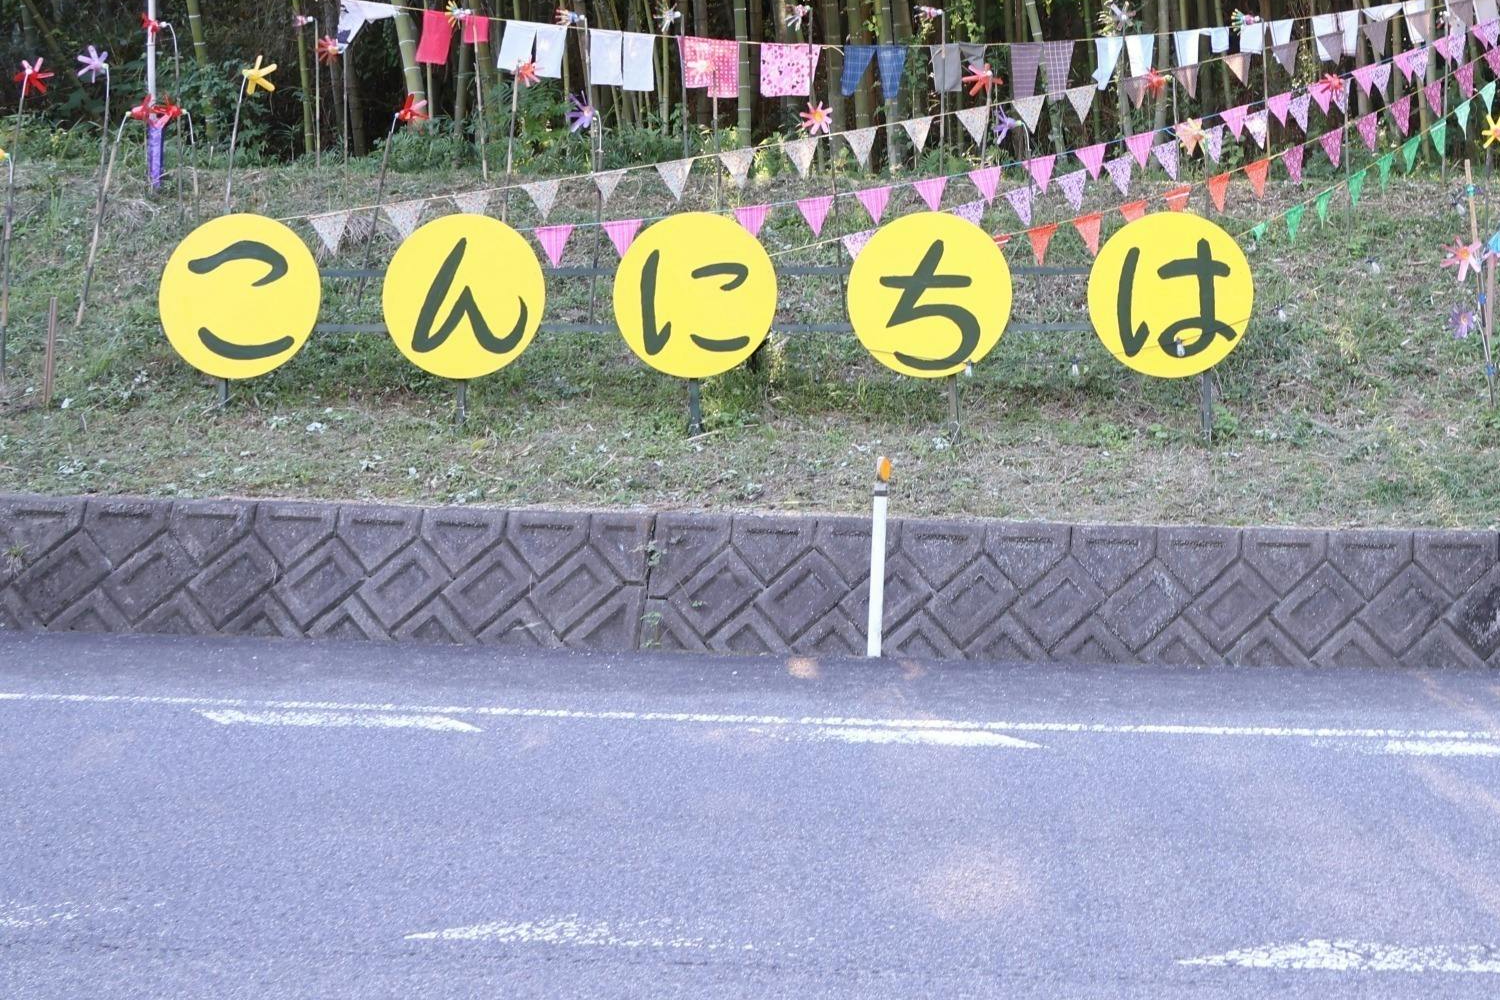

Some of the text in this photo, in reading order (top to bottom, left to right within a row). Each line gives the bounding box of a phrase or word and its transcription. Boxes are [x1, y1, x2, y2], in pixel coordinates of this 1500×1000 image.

[188, 237, 1239, 370] こんにちは
